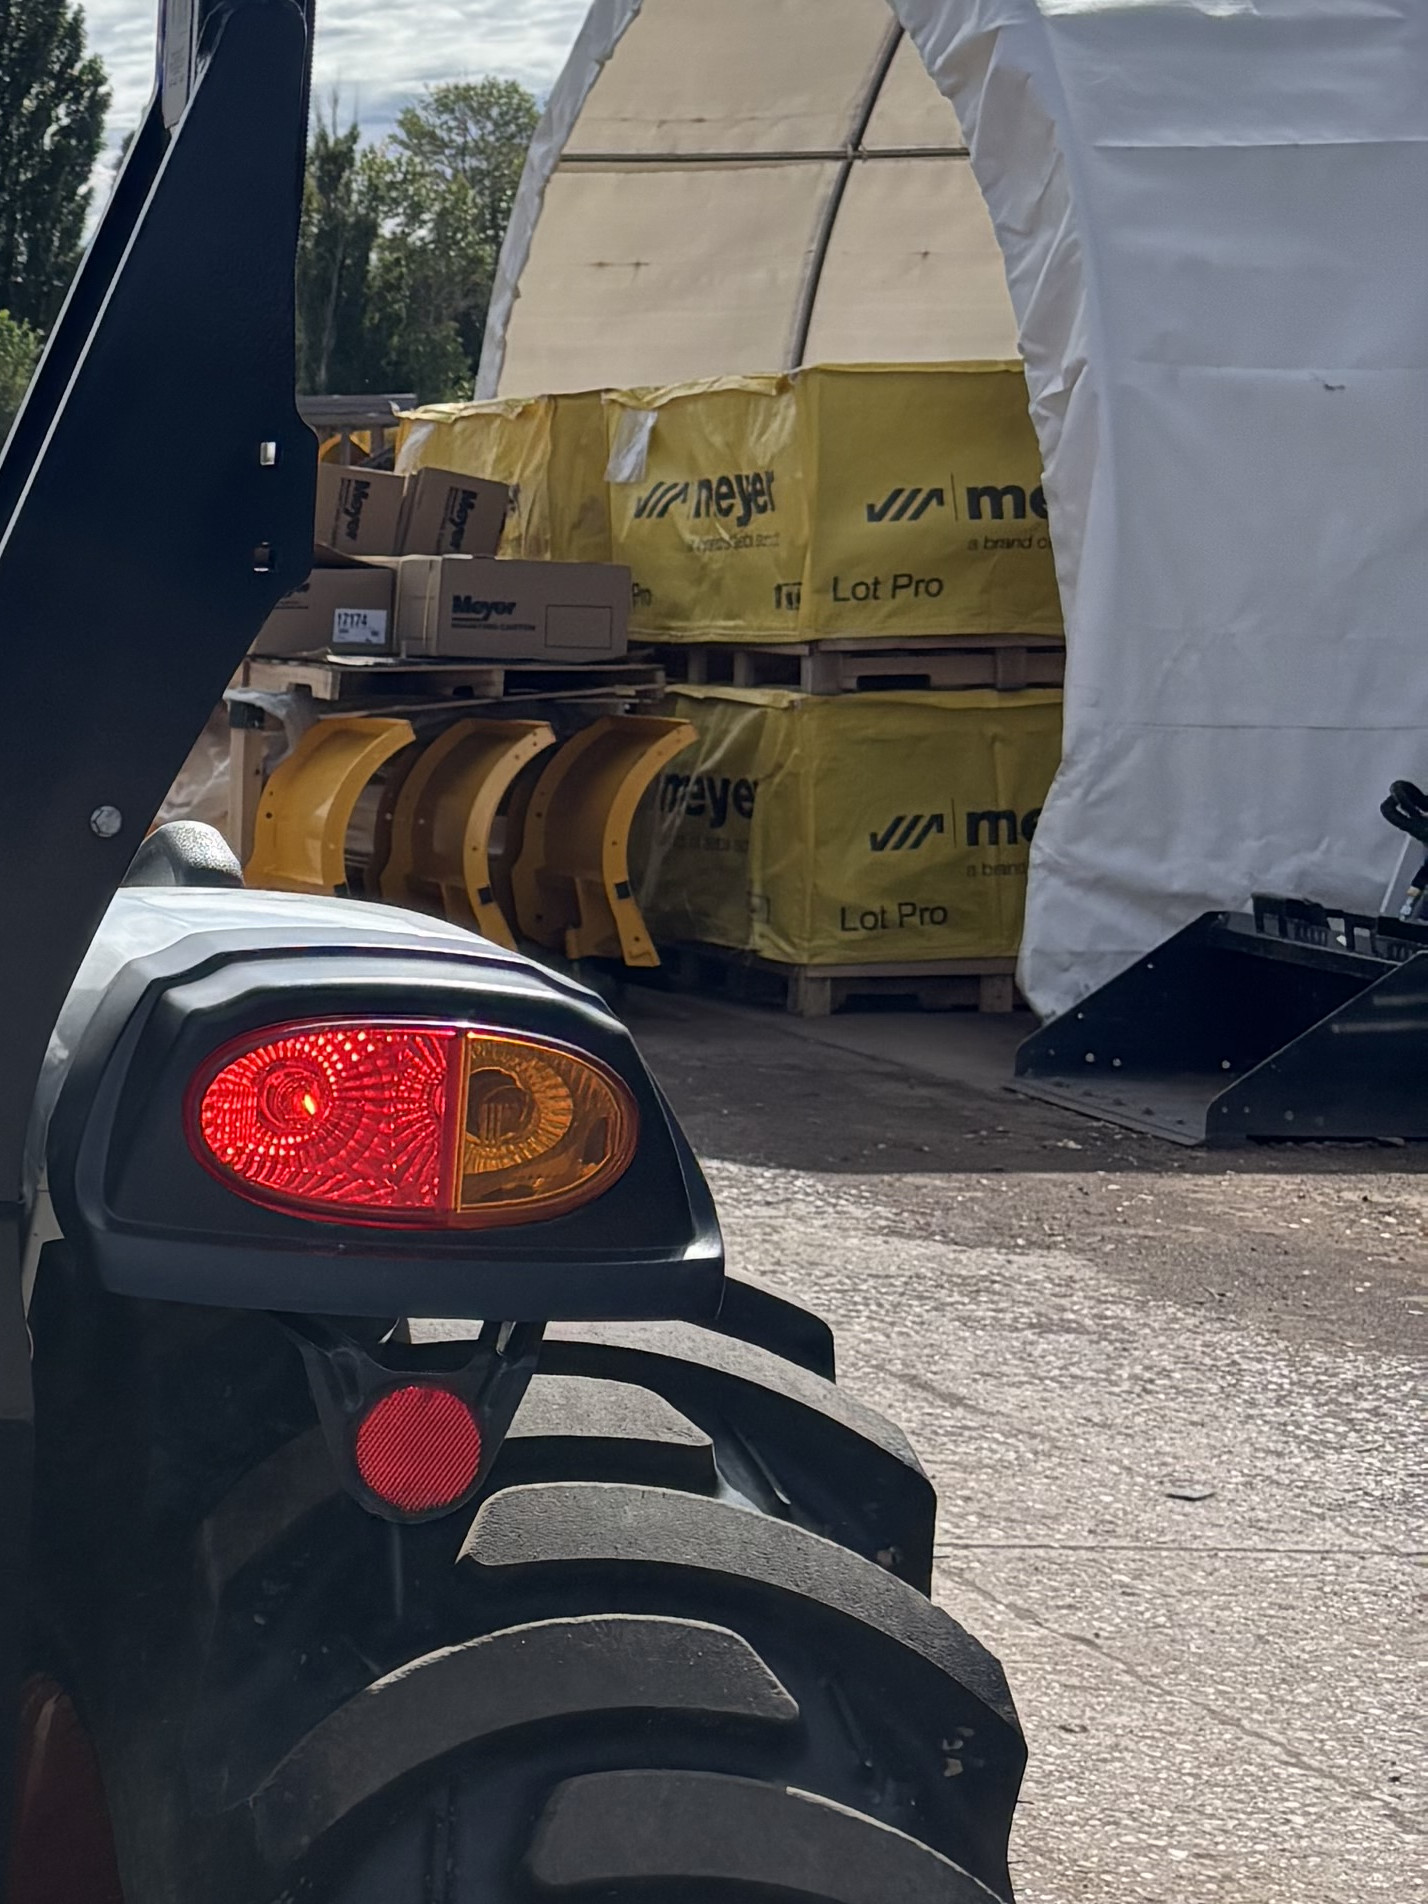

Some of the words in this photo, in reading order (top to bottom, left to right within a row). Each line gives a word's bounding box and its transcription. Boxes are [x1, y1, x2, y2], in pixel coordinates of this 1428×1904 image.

[833, 576, 881, 602] Lot
[891, 573, 944, 599] Pro
[451, 594, 517, 621] Meyer
[840, 905, 889, 932] Lot
[898, 902, 949, 928] Pro
